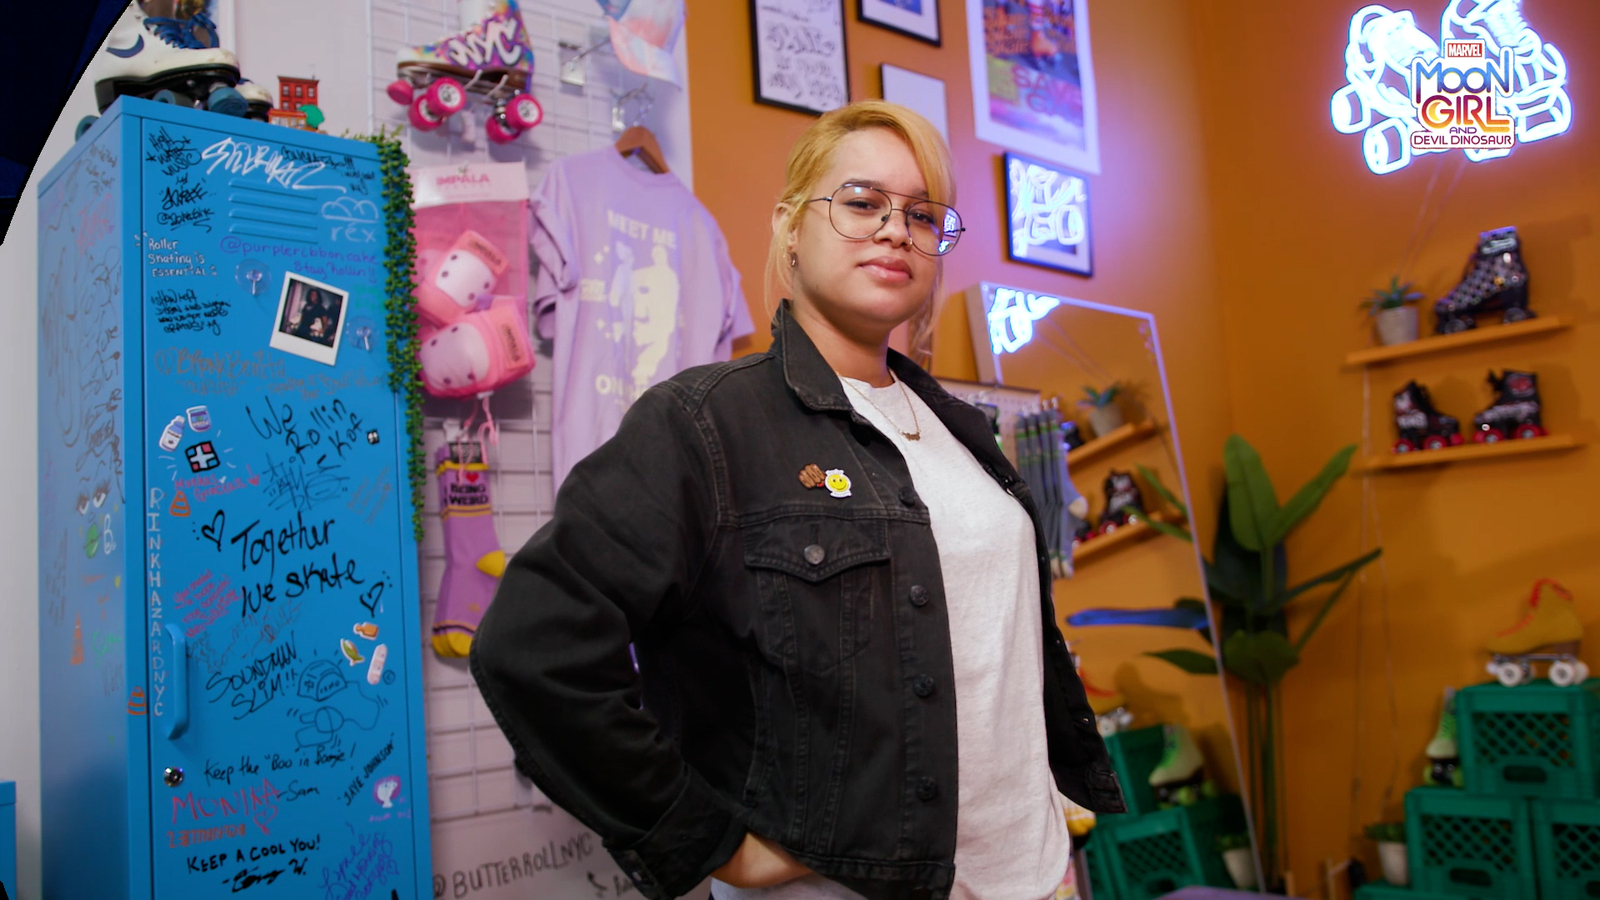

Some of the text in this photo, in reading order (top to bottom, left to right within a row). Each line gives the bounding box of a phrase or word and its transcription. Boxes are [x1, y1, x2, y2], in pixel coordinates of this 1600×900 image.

[450, 17, 522, 66] NYC
[148, 237, 179, 251] Roller
[194, 250, 205, 264] is
[245, 395, 298, 440] We
[448, 494, 489, 505] WEIRD
[204, 758, 234, 785] Keep
[239, 755, 260, 777] the
[172, 778, 281, 824] MONIKA
[187, 834, 320, 875] KEEP A COOL YOU!
